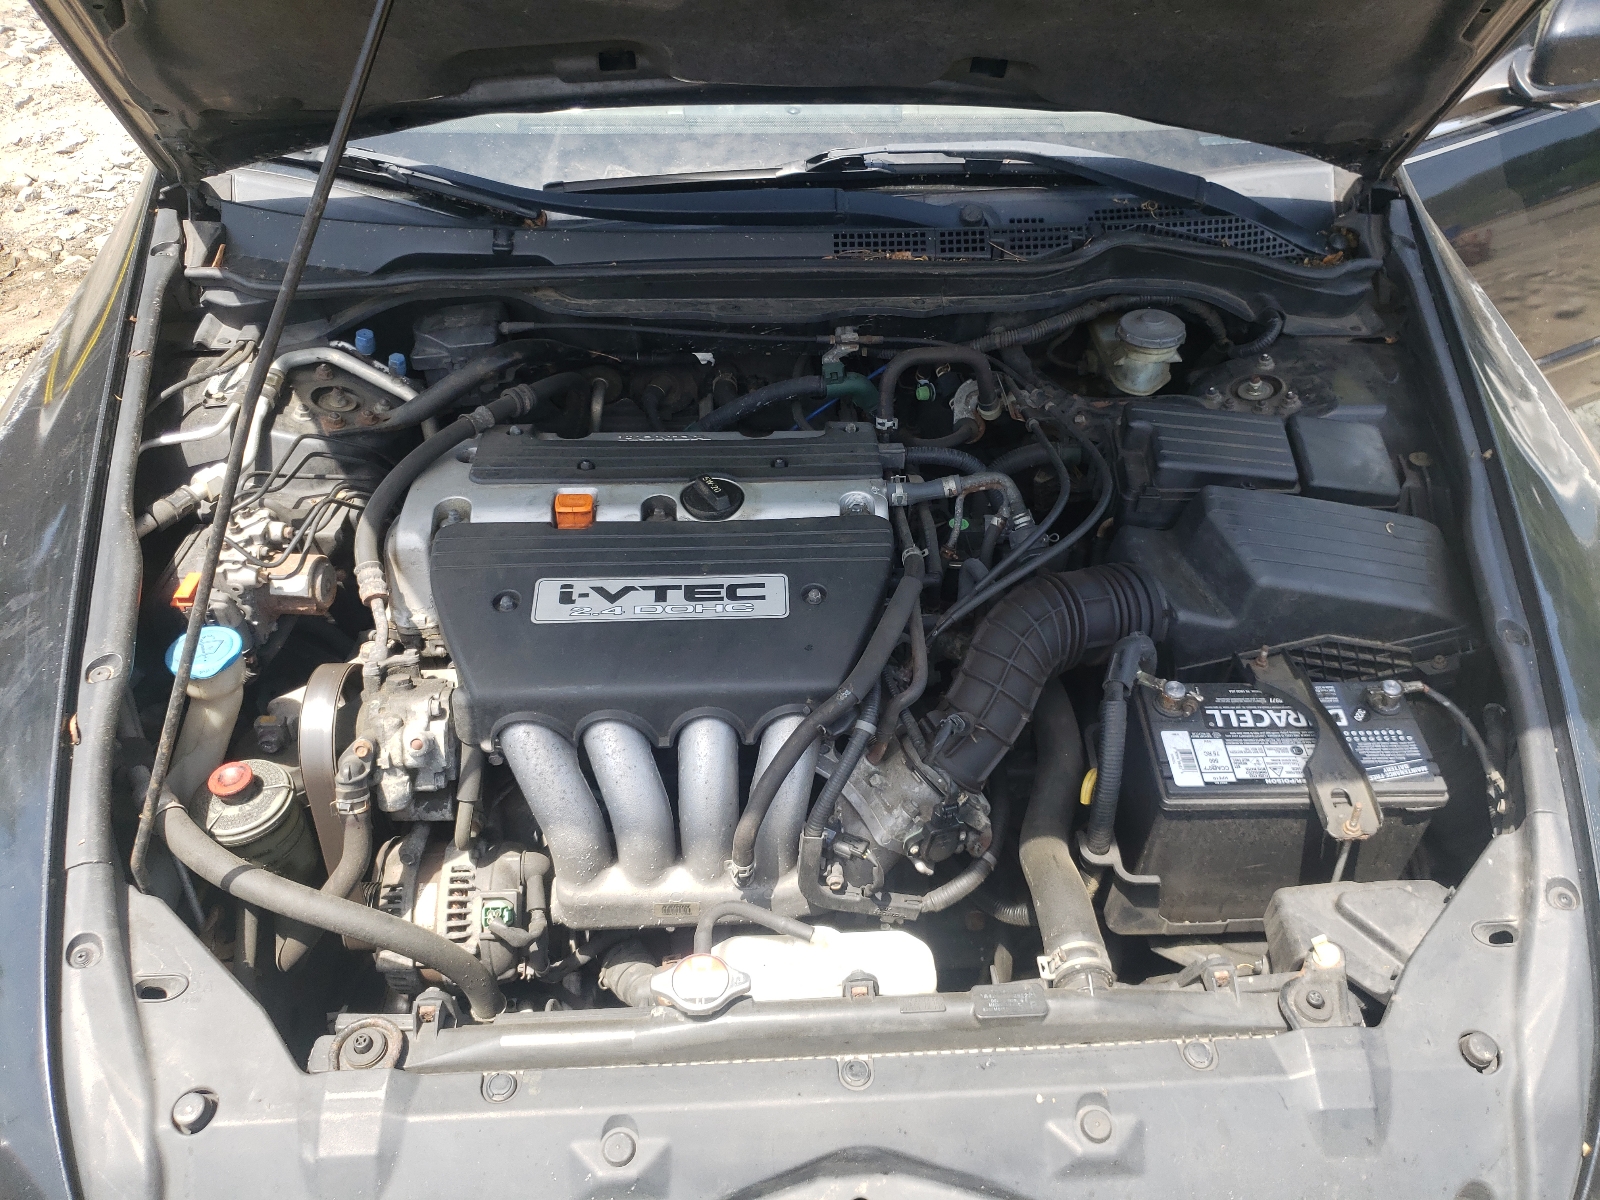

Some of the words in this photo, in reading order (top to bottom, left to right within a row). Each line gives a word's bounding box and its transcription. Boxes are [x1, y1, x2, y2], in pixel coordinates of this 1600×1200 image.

[702, 476, 722, 493] 5W-20
[558, 582, 766, 605] i-VTEC
[569, 605, 626, 617] 2.4
[633, 602, 755, 615] DOHC
[1206, 709, 1348, 727] DRACELL
[1383, 764, 1410, 773] BATTERY
